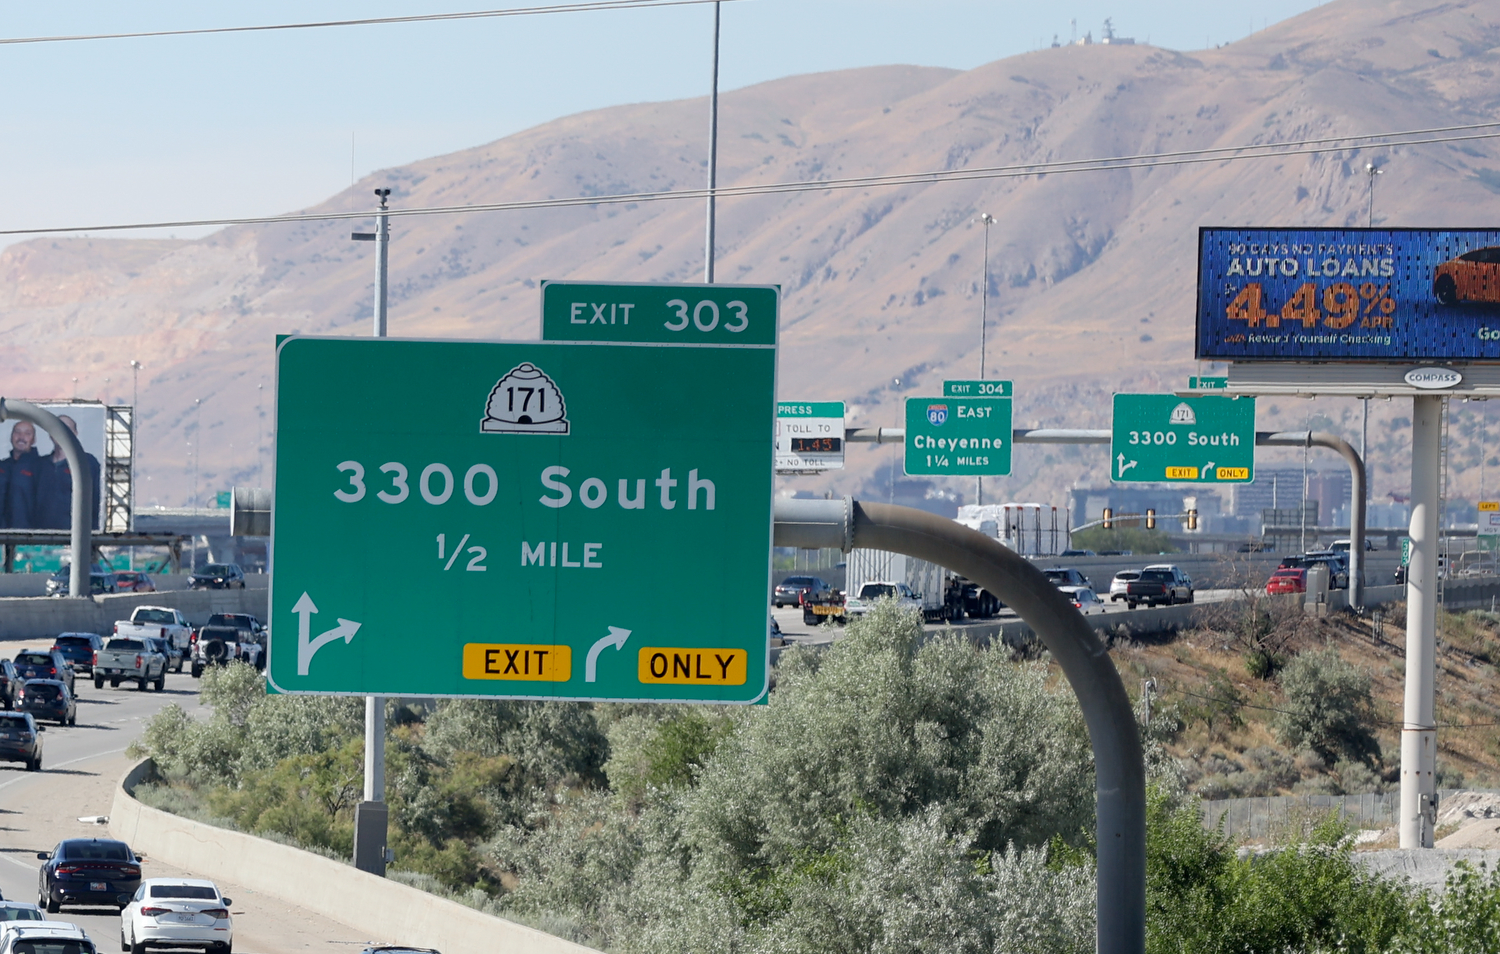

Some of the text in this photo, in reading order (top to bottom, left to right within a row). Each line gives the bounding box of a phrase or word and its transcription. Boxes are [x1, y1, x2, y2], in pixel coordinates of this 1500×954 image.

[1250, 243, 1289, 255] DAYS
[1292, 244, 1313, 255] NO
[1318, 244, 1394, 255] PAYMENTS
[1226, 258, 1395, 277] AUTO LOANS
[570, 299, 750, 332] EXIT 303
[1359, 316, 1393, 329] APR
[1248, 333, 1290, 343] Reward
[1293, 333, 1338, 343] Yourself
[1340, 333, 1391, 346] Checking
[1408, 373, 1458, 383] COMPASS
[951, 383, 1004, 394] EXIT 304
[506, 386, 547, 413] 171
[777, 405, 813, 415] PRESS
[930, 405, 992, 422] 80 EAST
[1176, 409, 1189, 418] 171
[786, 424, 831, 433] TOLL TO
[914, 435, 1002, 452] Cheyenne
[1128, 431, 1240, 446] 3300 South
[804, 459, 825, 467] TOLL
[957, 456, 989, 466] MILES
[1172, 468, 1245, 478] EXIT ONLY
[333, 460, 716, 511] 3300 South
[521, 542, 603, 569] MILE
[484, 650, 735, 680] EXIT ONLY
